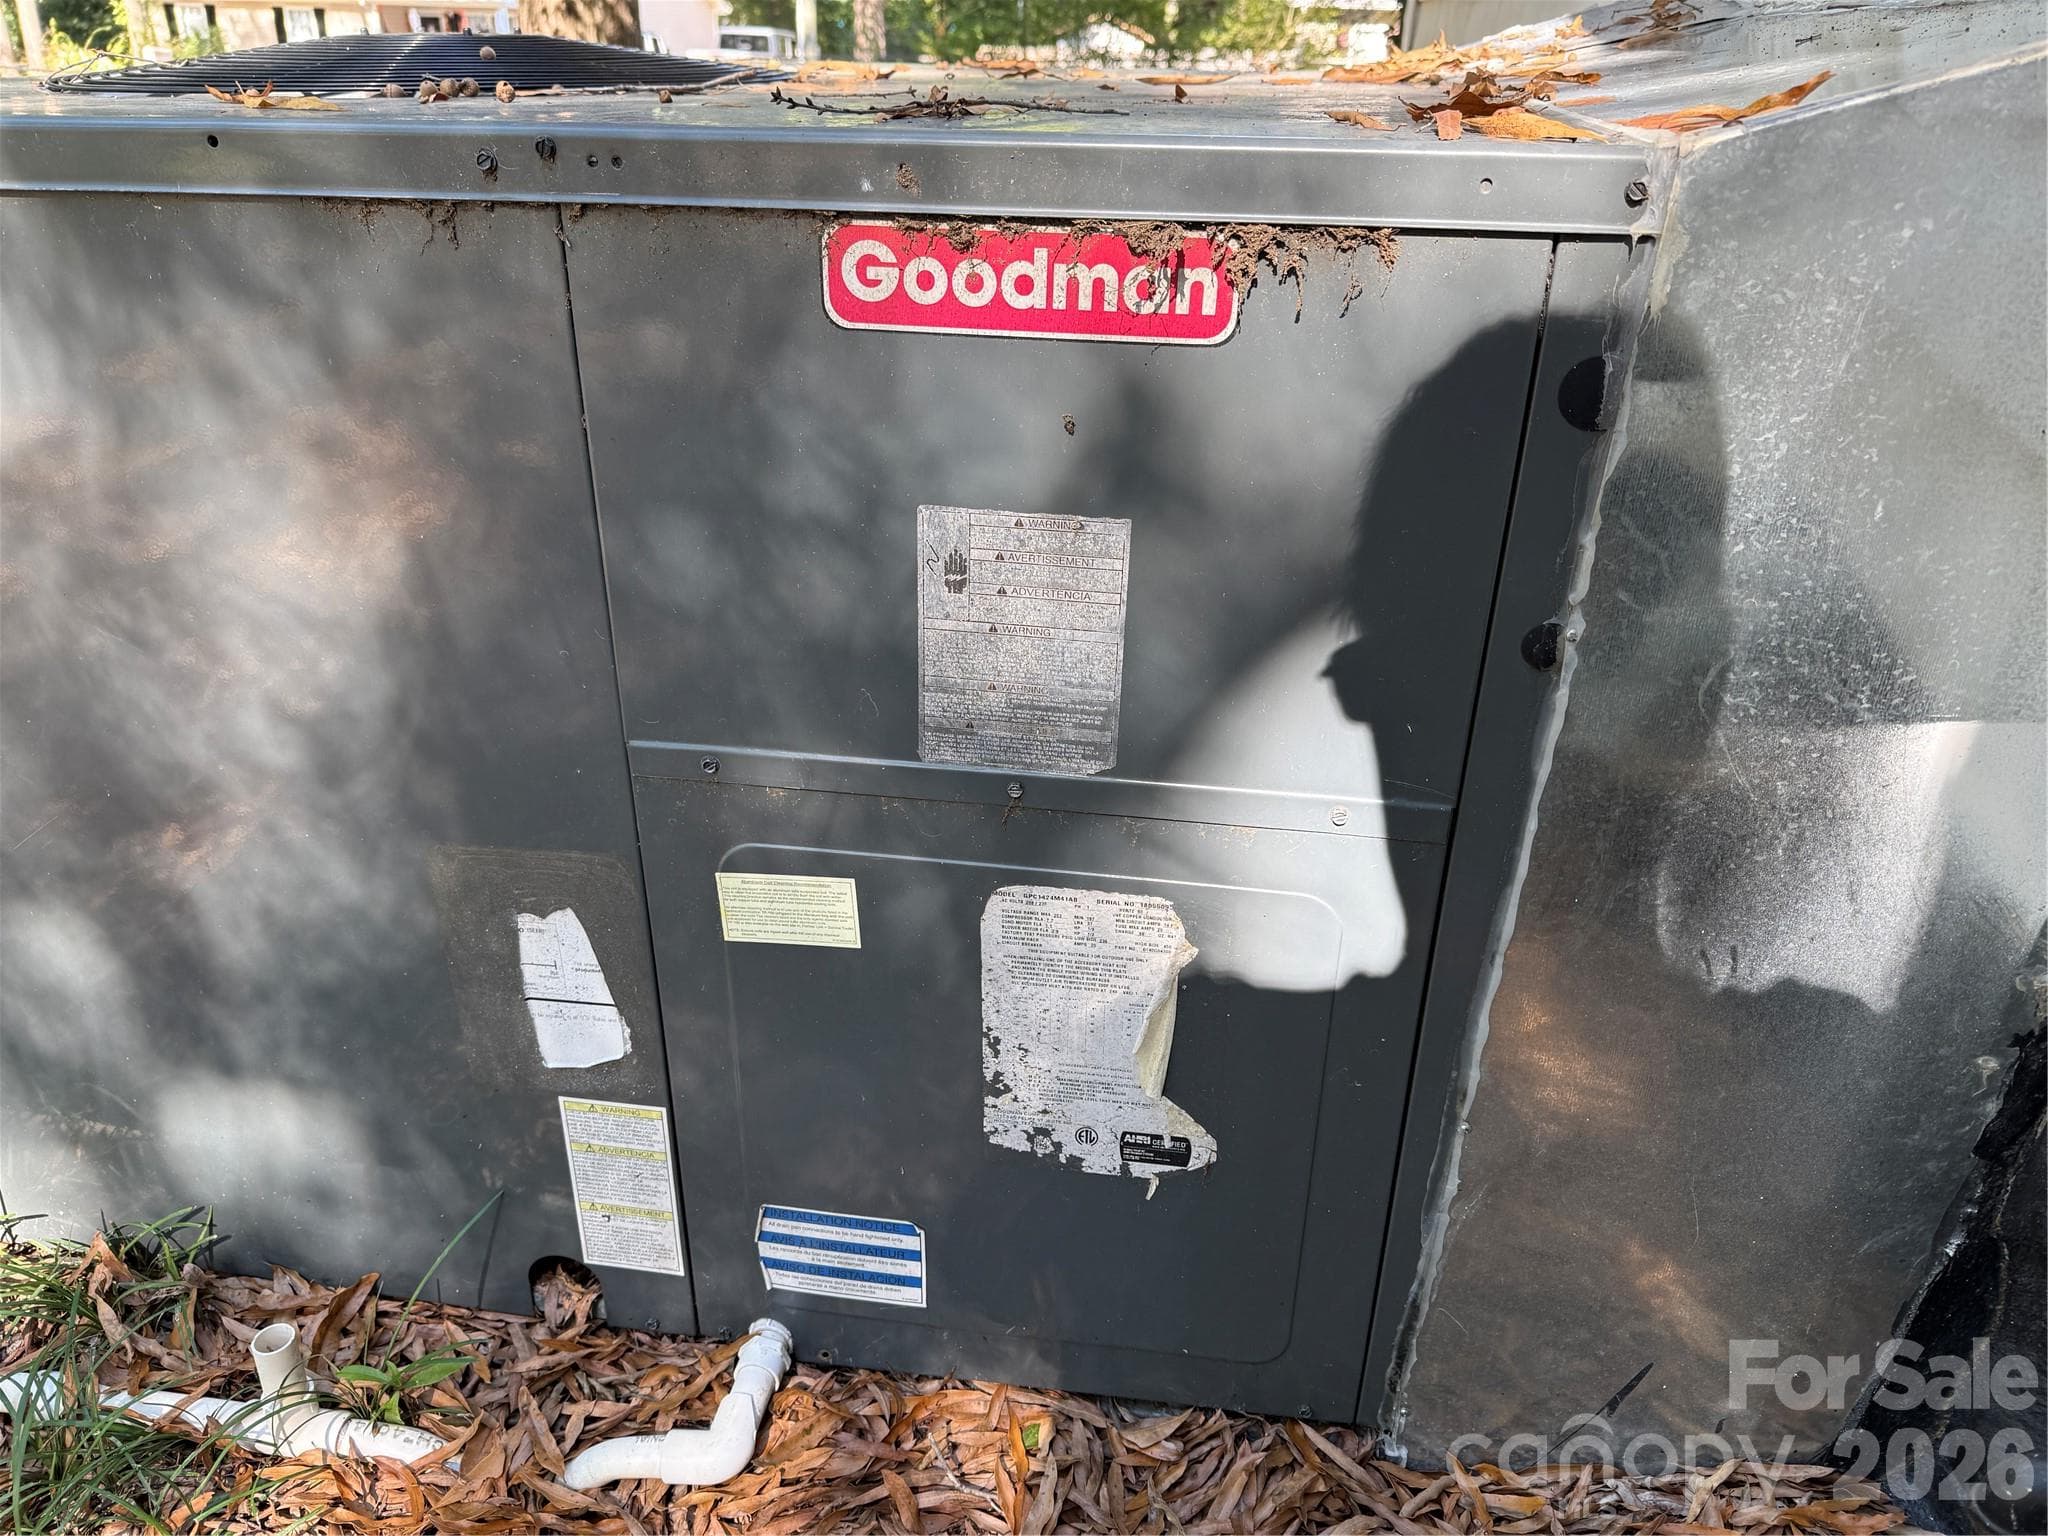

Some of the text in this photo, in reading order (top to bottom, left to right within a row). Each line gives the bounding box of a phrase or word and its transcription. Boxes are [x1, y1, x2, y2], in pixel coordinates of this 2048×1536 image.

[841, 239, 1218, 315] Goodman
[1008, 554, 1095, 567] AVERTISSEMENT
[1011, 587, 1091, 600] ADVERTENCIA
[1002, 626, 1050, 637] WARNING
[1001, 684, 1048, 695] WARNING
[601, 1107, 641, 1116] WARNING
[598, 1147, 655, 1158] ADVERTENCIA
[600, 1204, 665, 1217] AVERTISSEMENT
[770, 1208, 901, 1232] INSTALLATION NOTICE
[771, 1235, 796, 1246] AVIS
[772, 1260, 808, 1272] AVISO
[809, 1265, 825, 1275] DE
